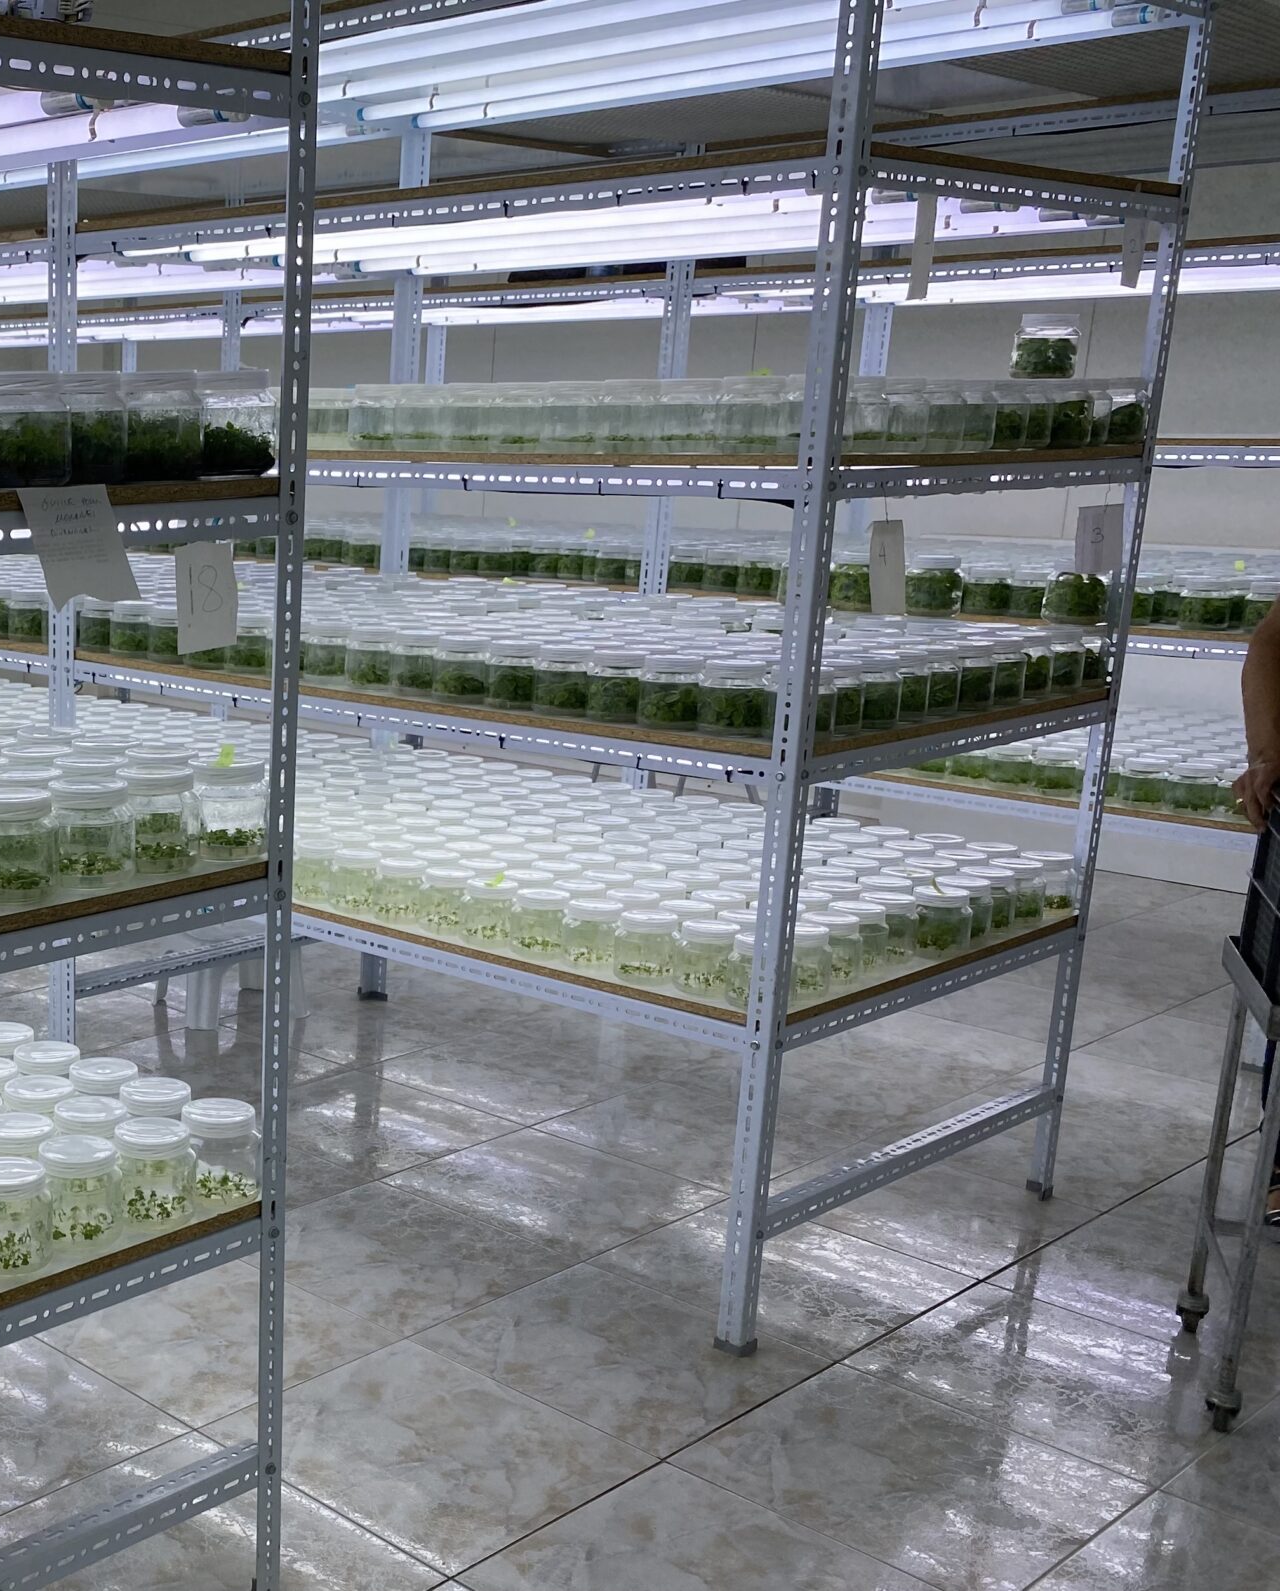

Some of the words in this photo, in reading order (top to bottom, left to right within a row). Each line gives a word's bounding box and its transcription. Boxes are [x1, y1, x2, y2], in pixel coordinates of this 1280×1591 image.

[1090, 527, 1105, 544] 3
[878, 542, 887, 567] 4
[188, 564, 224, 616] 18
